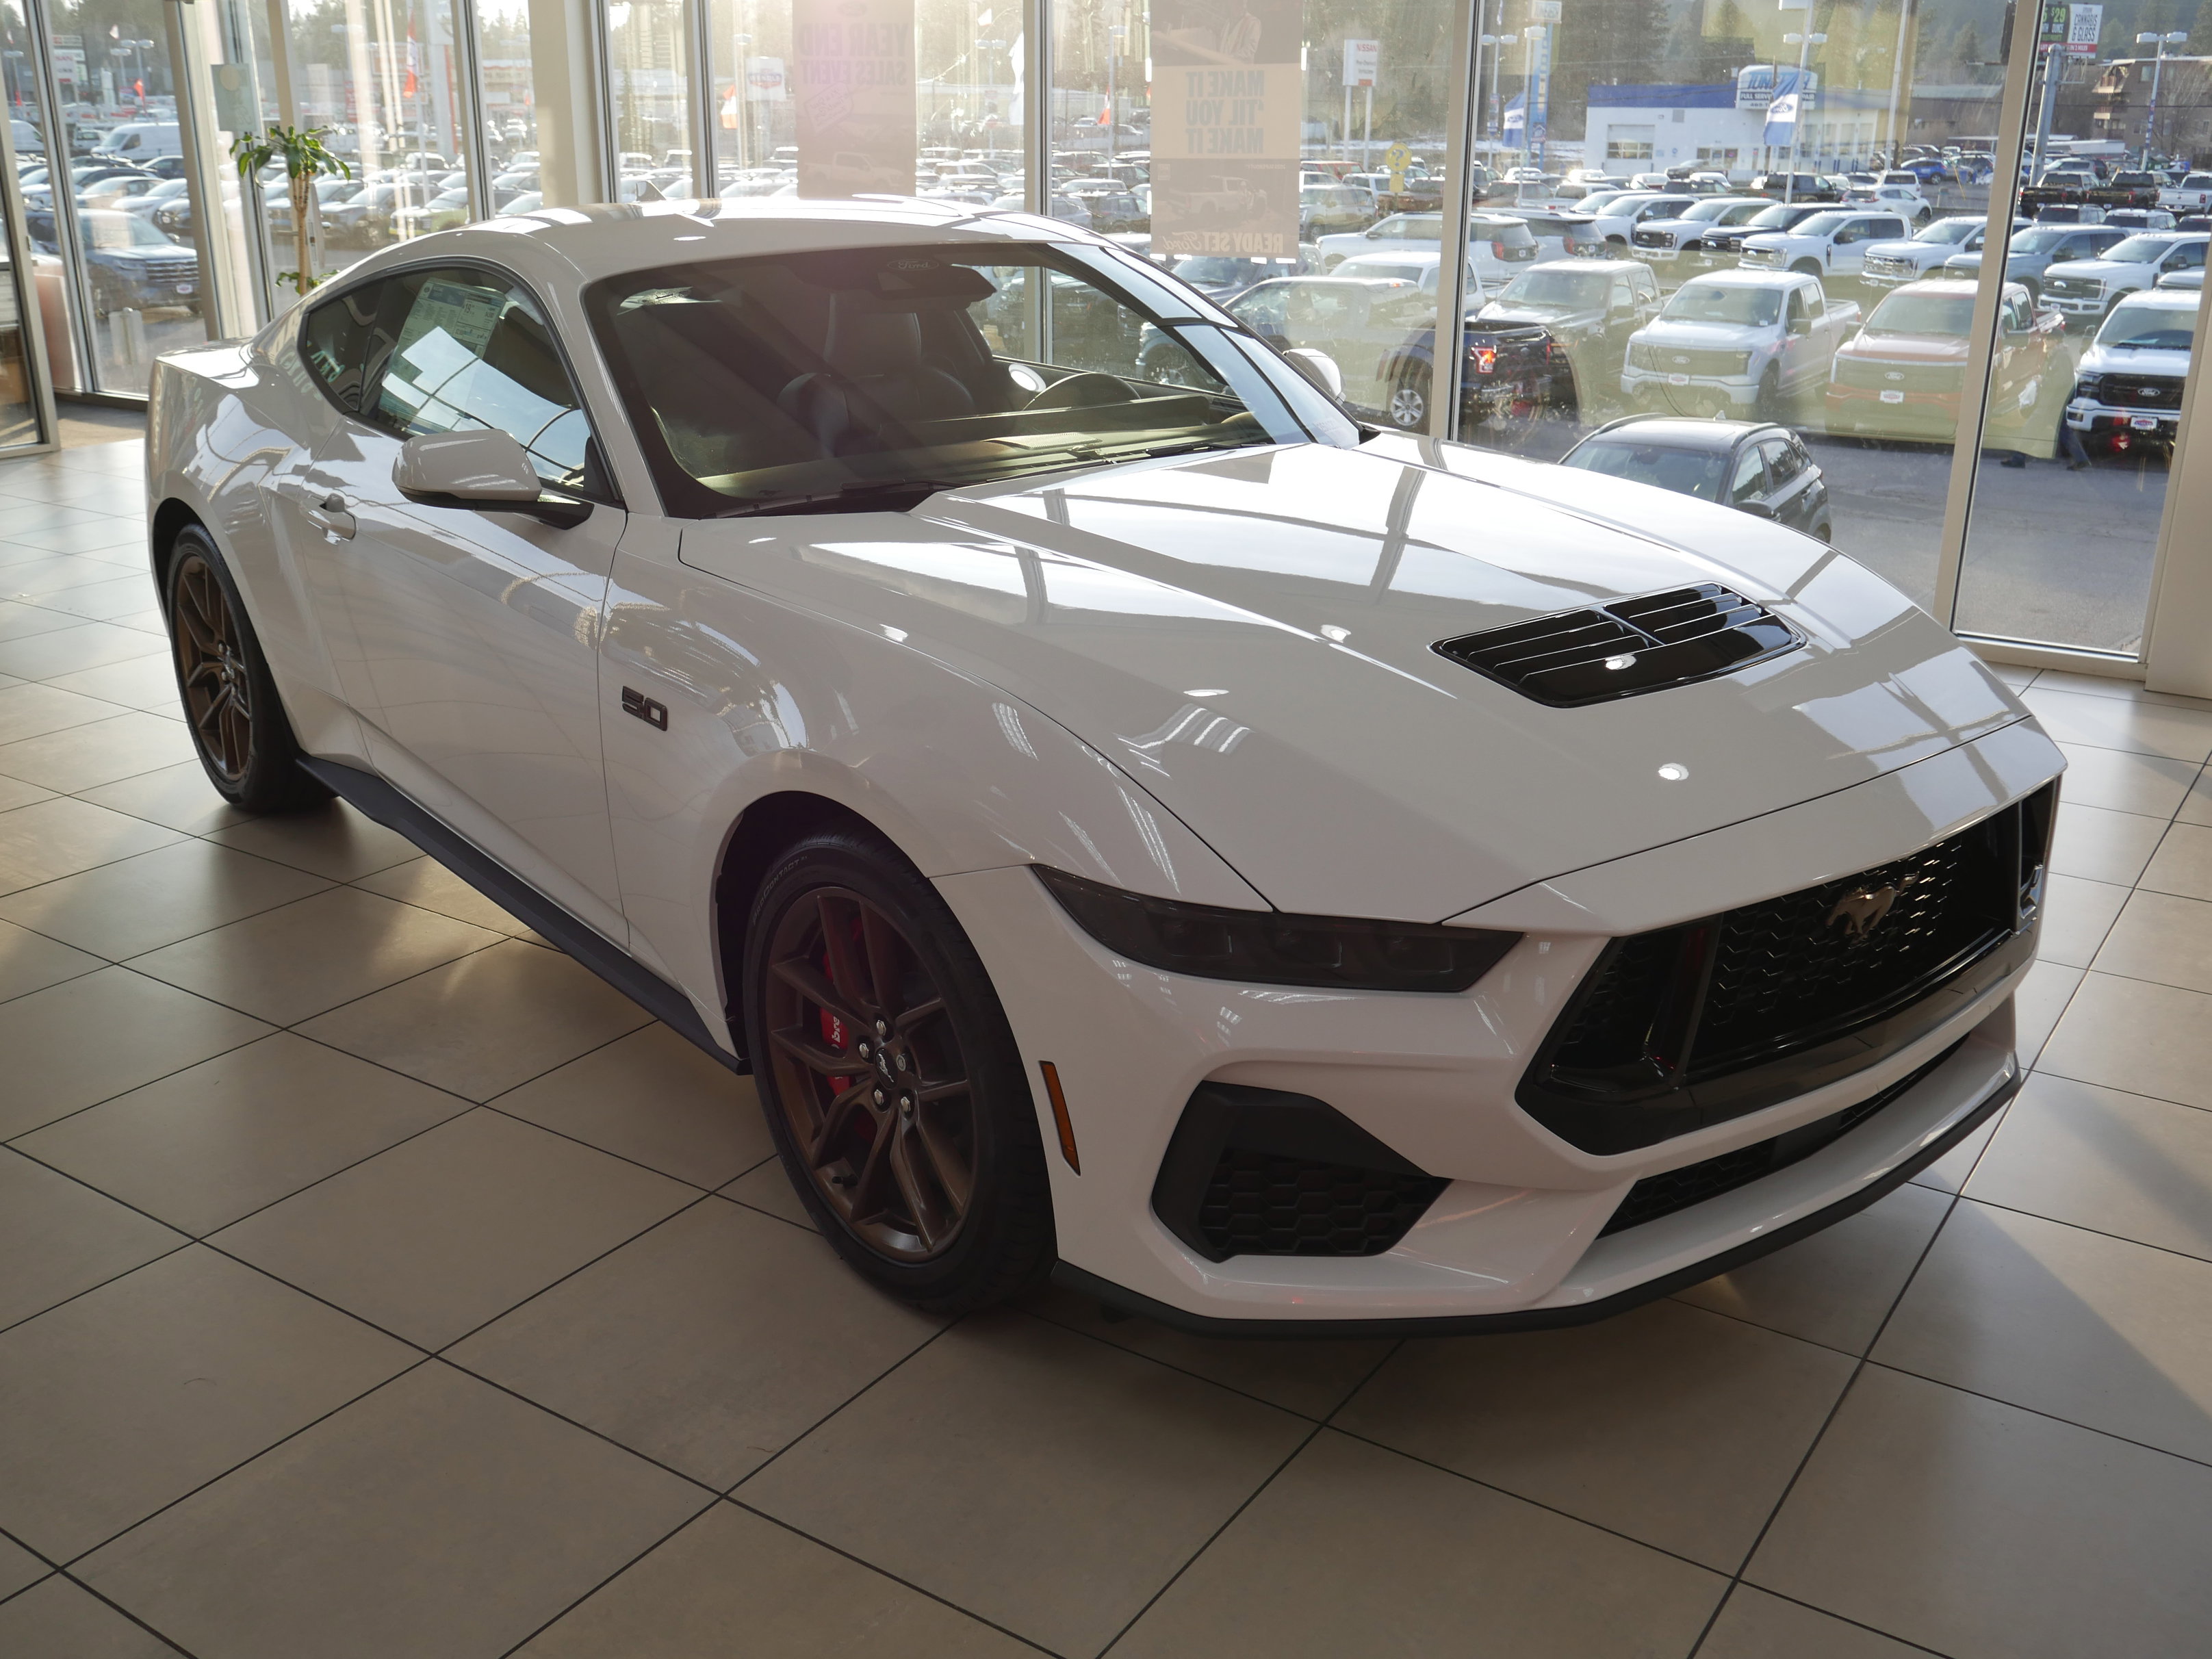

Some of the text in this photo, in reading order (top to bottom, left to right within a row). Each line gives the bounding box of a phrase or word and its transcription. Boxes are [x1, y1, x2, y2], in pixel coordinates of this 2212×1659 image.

[2077, 27, 2096, 42] GLASS
[1356, 43, 1377, 52] NISSAN
[897, 260, 931, 270] Ford
